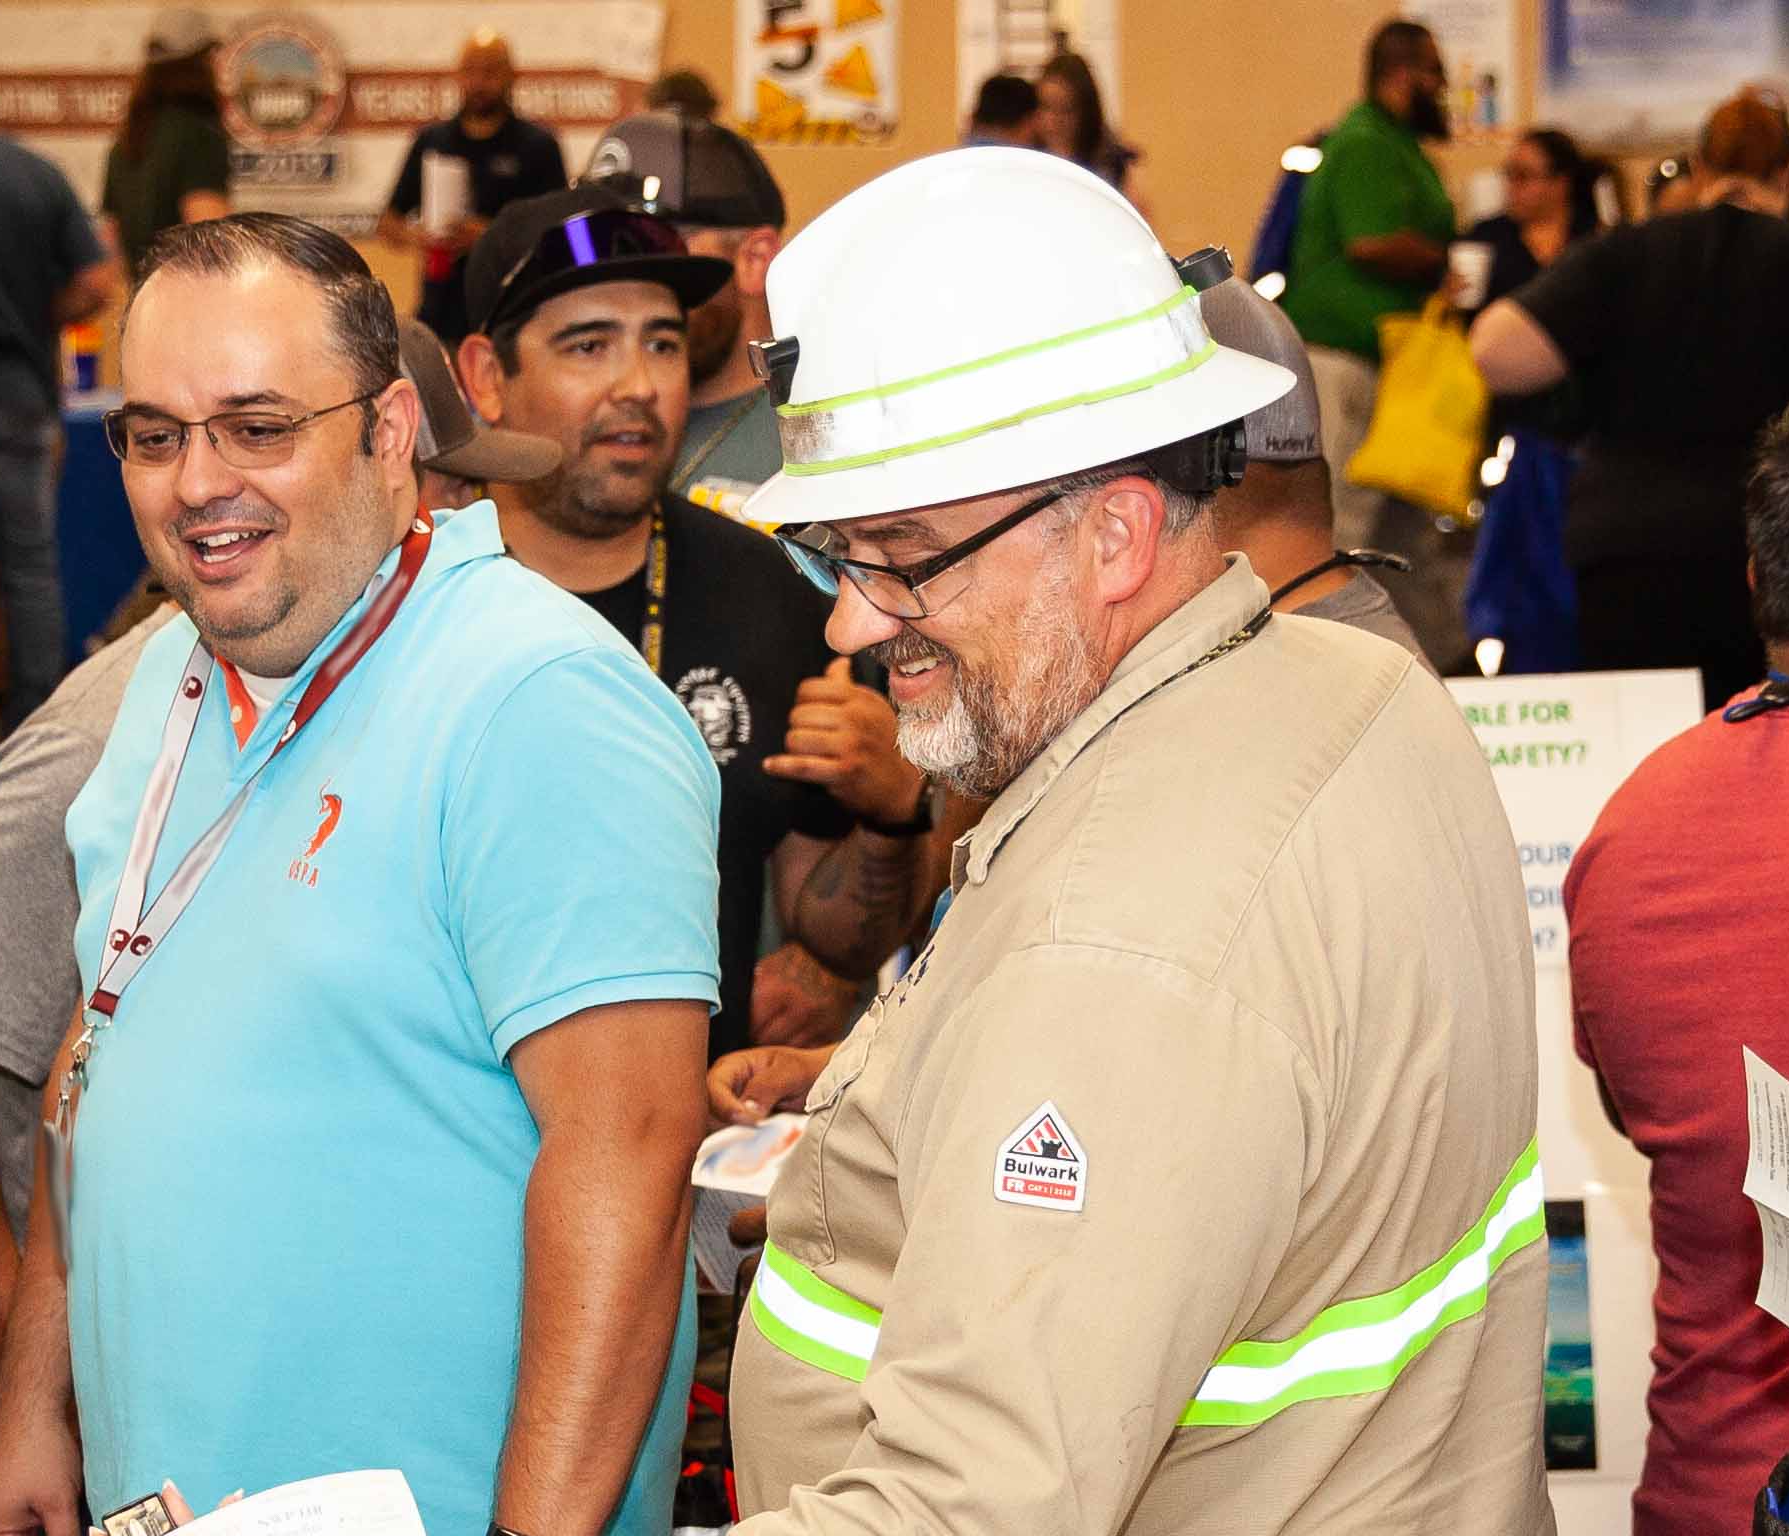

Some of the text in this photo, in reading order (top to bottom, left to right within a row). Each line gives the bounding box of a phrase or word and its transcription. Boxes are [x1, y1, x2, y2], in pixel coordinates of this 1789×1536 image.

[1466, 702, 1571, 725] BLE FOR
[1005, 1158, 1078, 1181] Bulwark
[1007, 1179, 1025, 1192] FR
